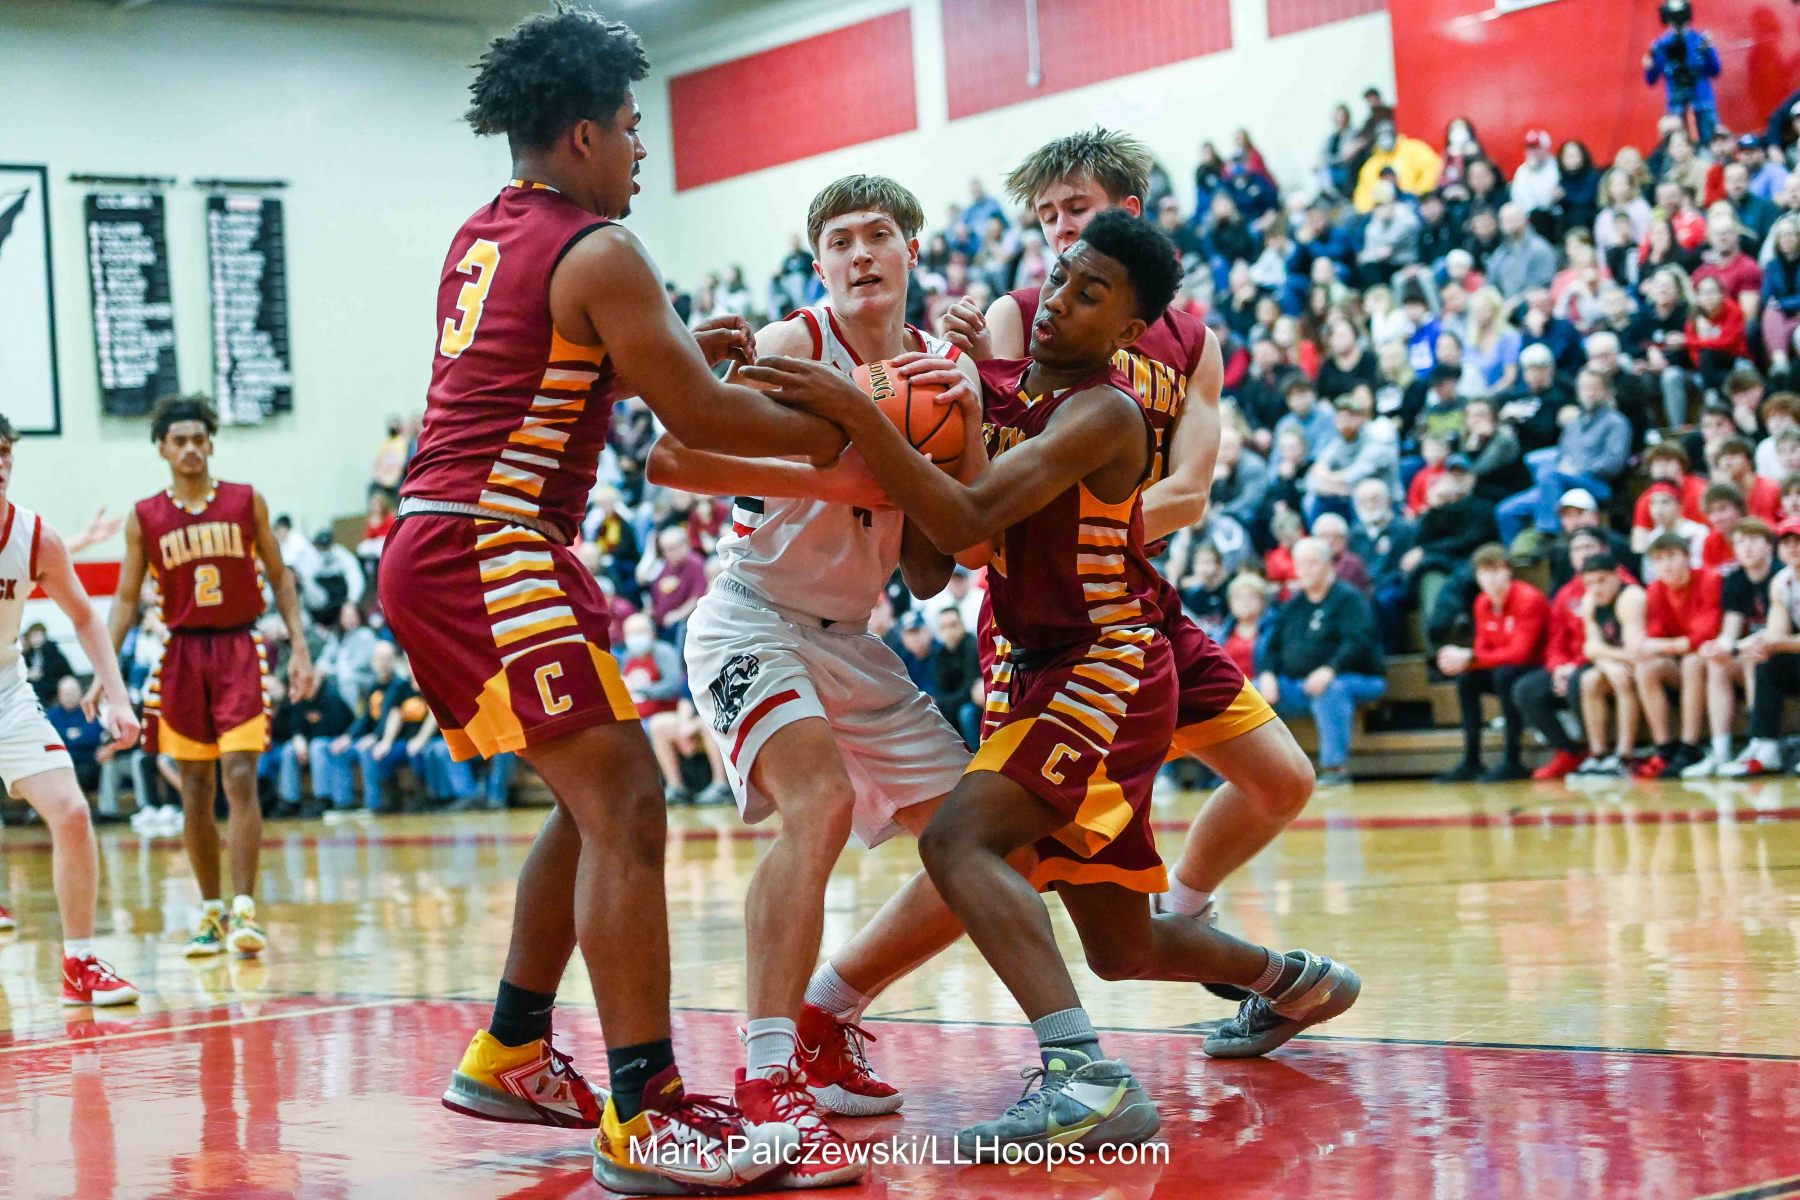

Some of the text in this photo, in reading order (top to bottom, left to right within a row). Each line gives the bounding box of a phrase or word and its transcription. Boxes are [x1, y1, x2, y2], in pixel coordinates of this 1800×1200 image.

[439, 238, 501, 359] 3
[194, 564, 223, 607] 2
[533, 661, 573, 716] C
[1041, 742, 1081, 785] C
